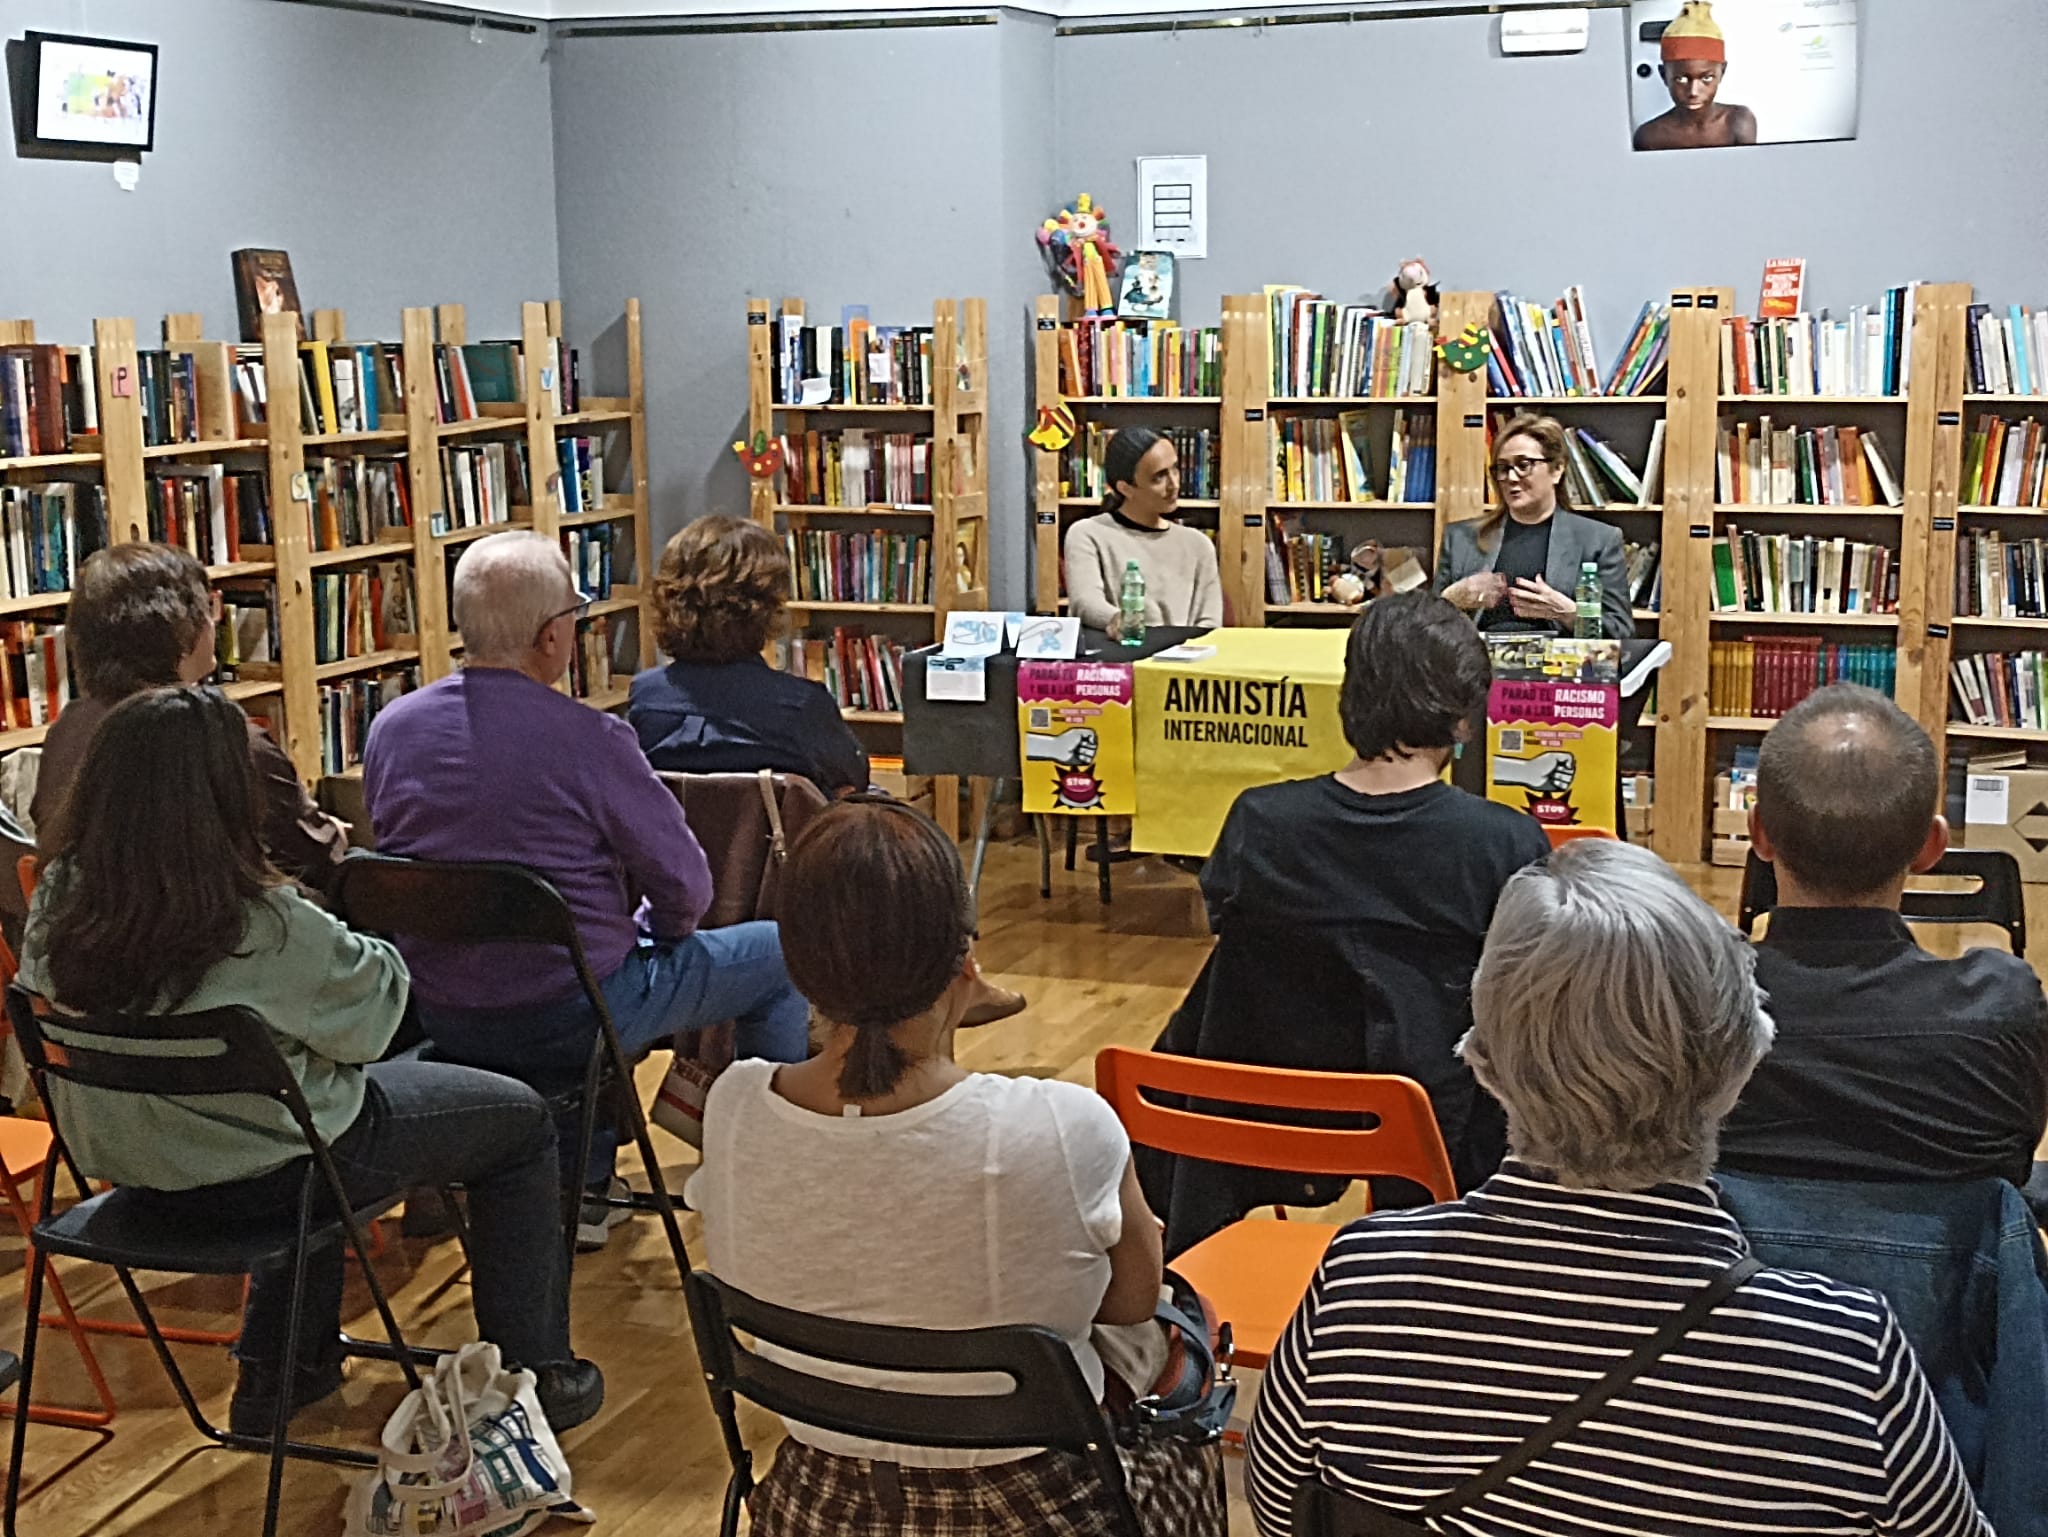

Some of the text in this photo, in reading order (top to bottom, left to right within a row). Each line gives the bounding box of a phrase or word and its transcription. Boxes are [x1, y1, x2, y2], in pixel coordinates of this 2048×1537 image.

[117, 366, 128, 393] P
[540, 369, 553, 389] V
[295, 473, 305, 498] S
[431, 512, 443, 534] T
[1076, 684, 1120, 696] PERSONAS
[1164, 676, 1307, 718] AMNISTÍA
[1555, 689, 1606, 704] RACISMO
[1554, 705, 1605, 719] PERSONAS
[1164, 719, 1308, 748] INTERNACIONAL
[1066, 777, 1091, 787] STOP
[1537, 805, 1565, 814] STOP
